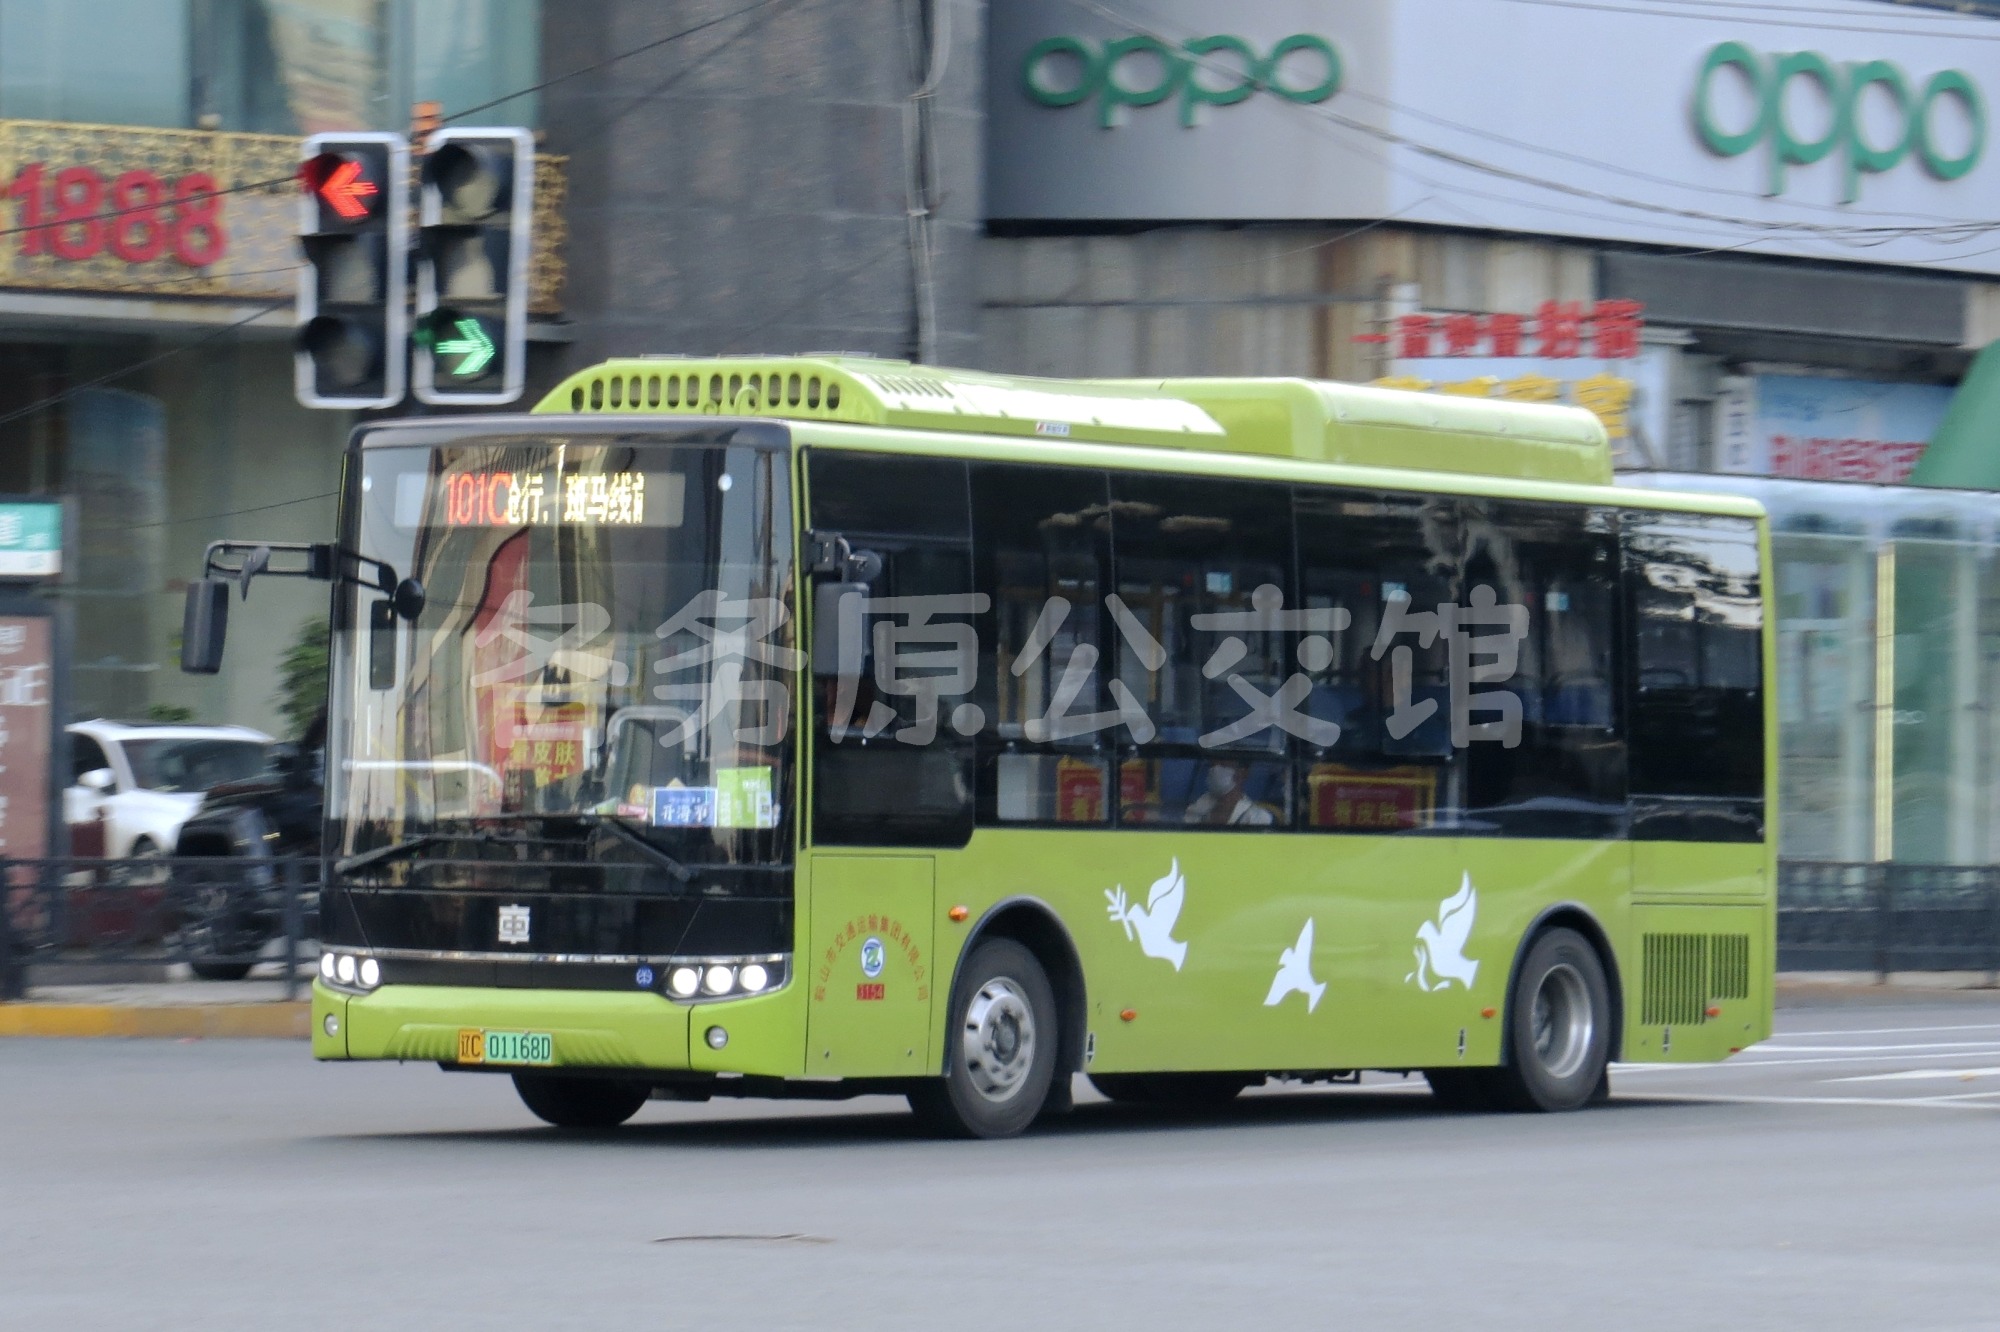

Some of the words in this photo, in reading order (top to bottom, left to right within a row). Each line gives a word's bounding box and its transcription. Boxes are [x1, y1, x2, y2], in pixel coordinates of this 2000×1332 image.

[9, 162, 228, 266] 1888
[446, 472, 511, 525] 101C
[460, 1034, 481, 1058] 辽C
[489, 1035, 551, 1059] 01168D
